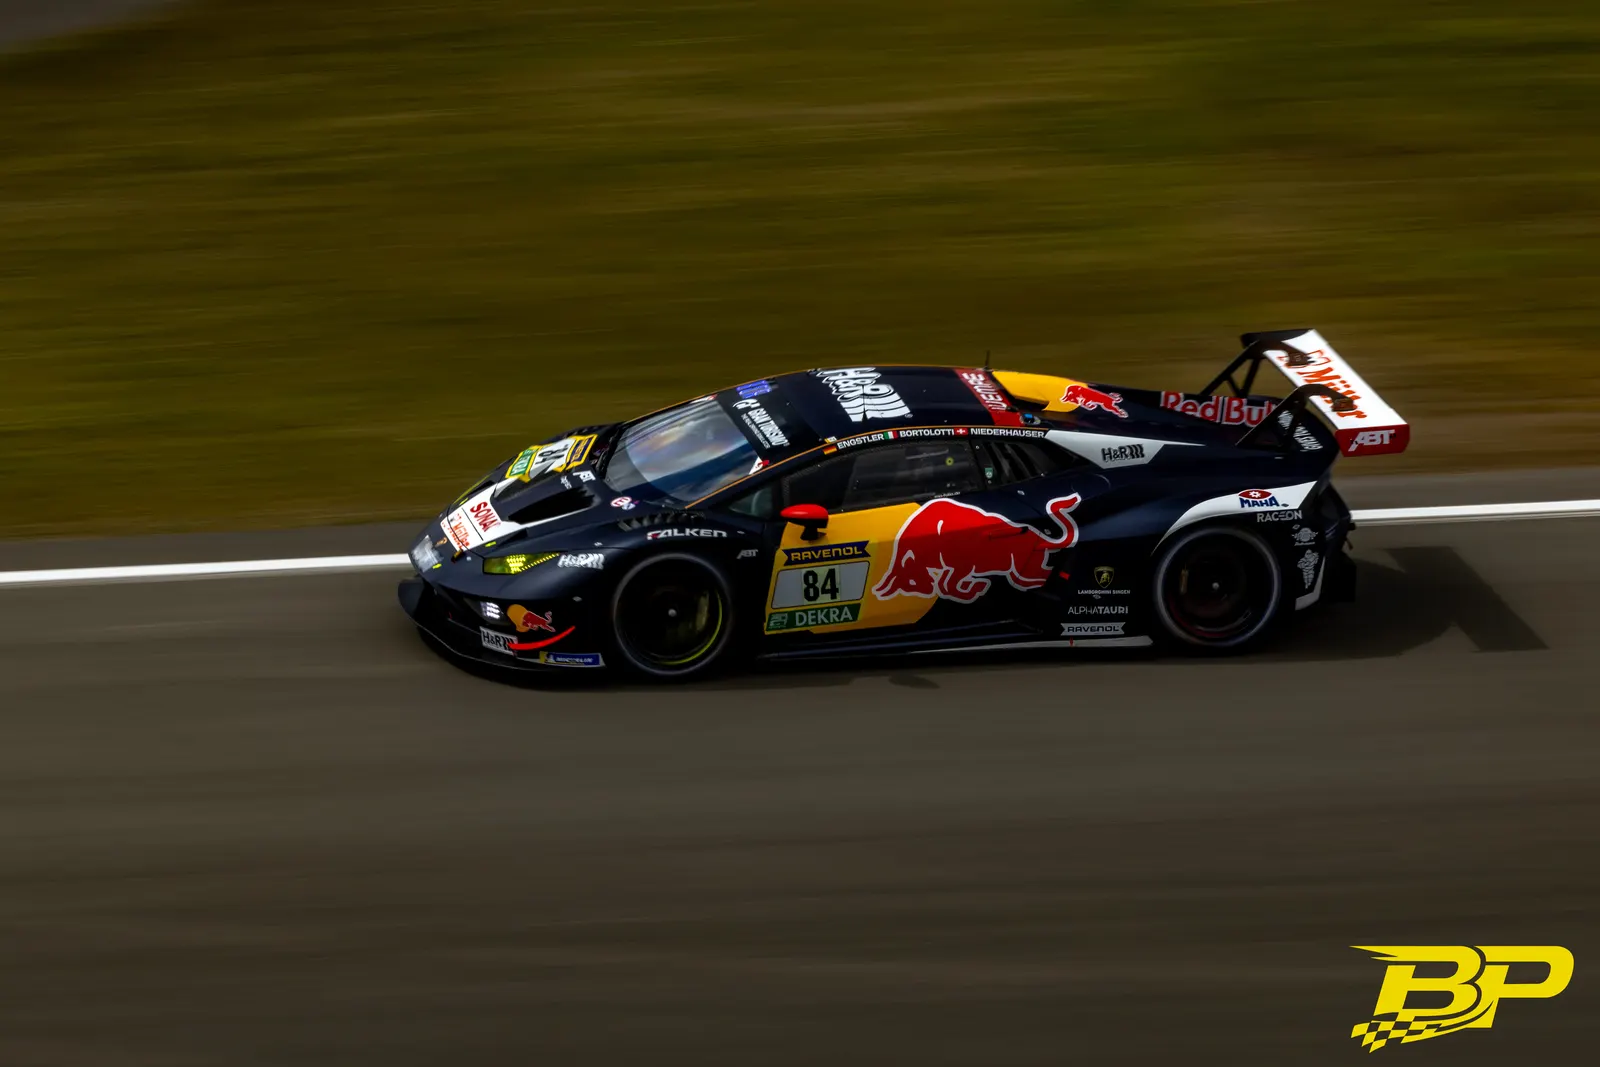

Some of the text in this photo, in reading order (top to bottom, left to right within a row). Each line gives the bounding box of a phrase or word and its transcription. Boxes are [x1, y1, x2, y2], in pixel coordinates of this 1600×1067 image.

[1160, 391, 1223, 423] Red
[1221, 396, 1276, 427] Bul
[836, 433, 885, 449] ENGSTLER
[900, 428, 955, 437] BORTOLOTTI
[970, 428, 1045, 438] NIEDERHAUSER
[1348, 430, 1396, 452] ABT
[1101, 447, 1128, 462] H&R
[1239, 496, 1280, 508] MAHA
[1256, 510, 1303, 522] RACEON
[646, 528, 727, 540] FALKEN
[736, 549, 759, 559] ABT
[790, 546, 862, 561] RAVENOL
[803, 568, 839, 602] 84
[795, 606, 853, 626] DEKRA
[1068, 606, 1129, 614] ALPHATAURI
[1067, 625, 1120, 633] RAVENOL
[482, 631, 503, 648] H&R
